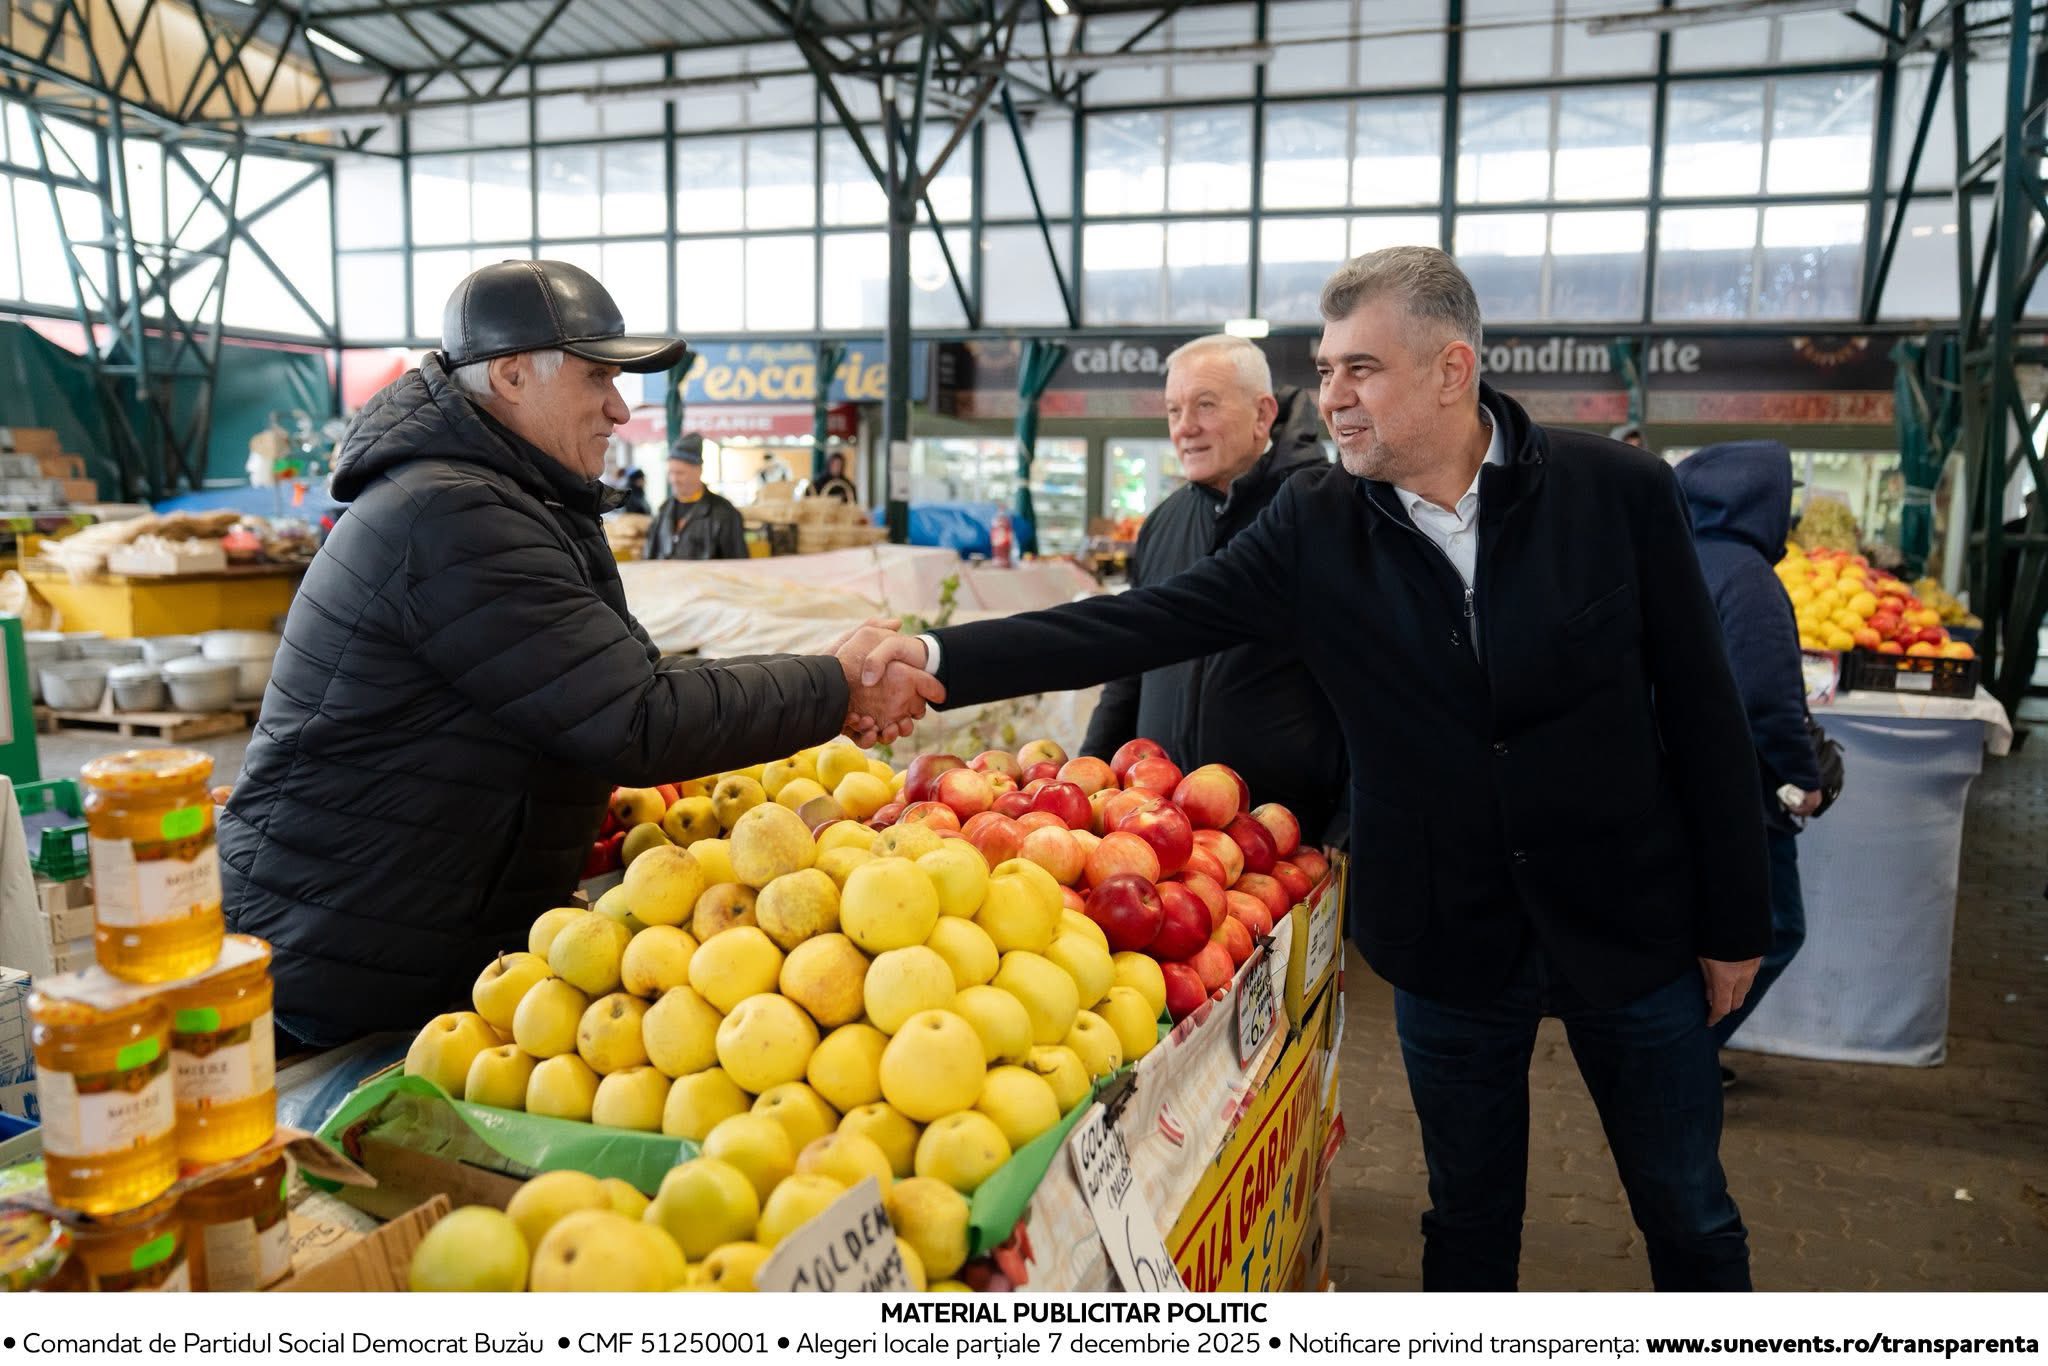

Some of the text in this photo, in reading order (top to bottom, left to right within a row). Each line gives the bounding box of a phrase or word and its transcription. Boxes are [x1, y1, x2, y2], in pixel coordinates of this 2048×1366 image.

[1072, 340, 1167, 376] cafea,
[1481, 336, 1700, 373] condimte
[651, 415, 774, 433] PSCARIE
